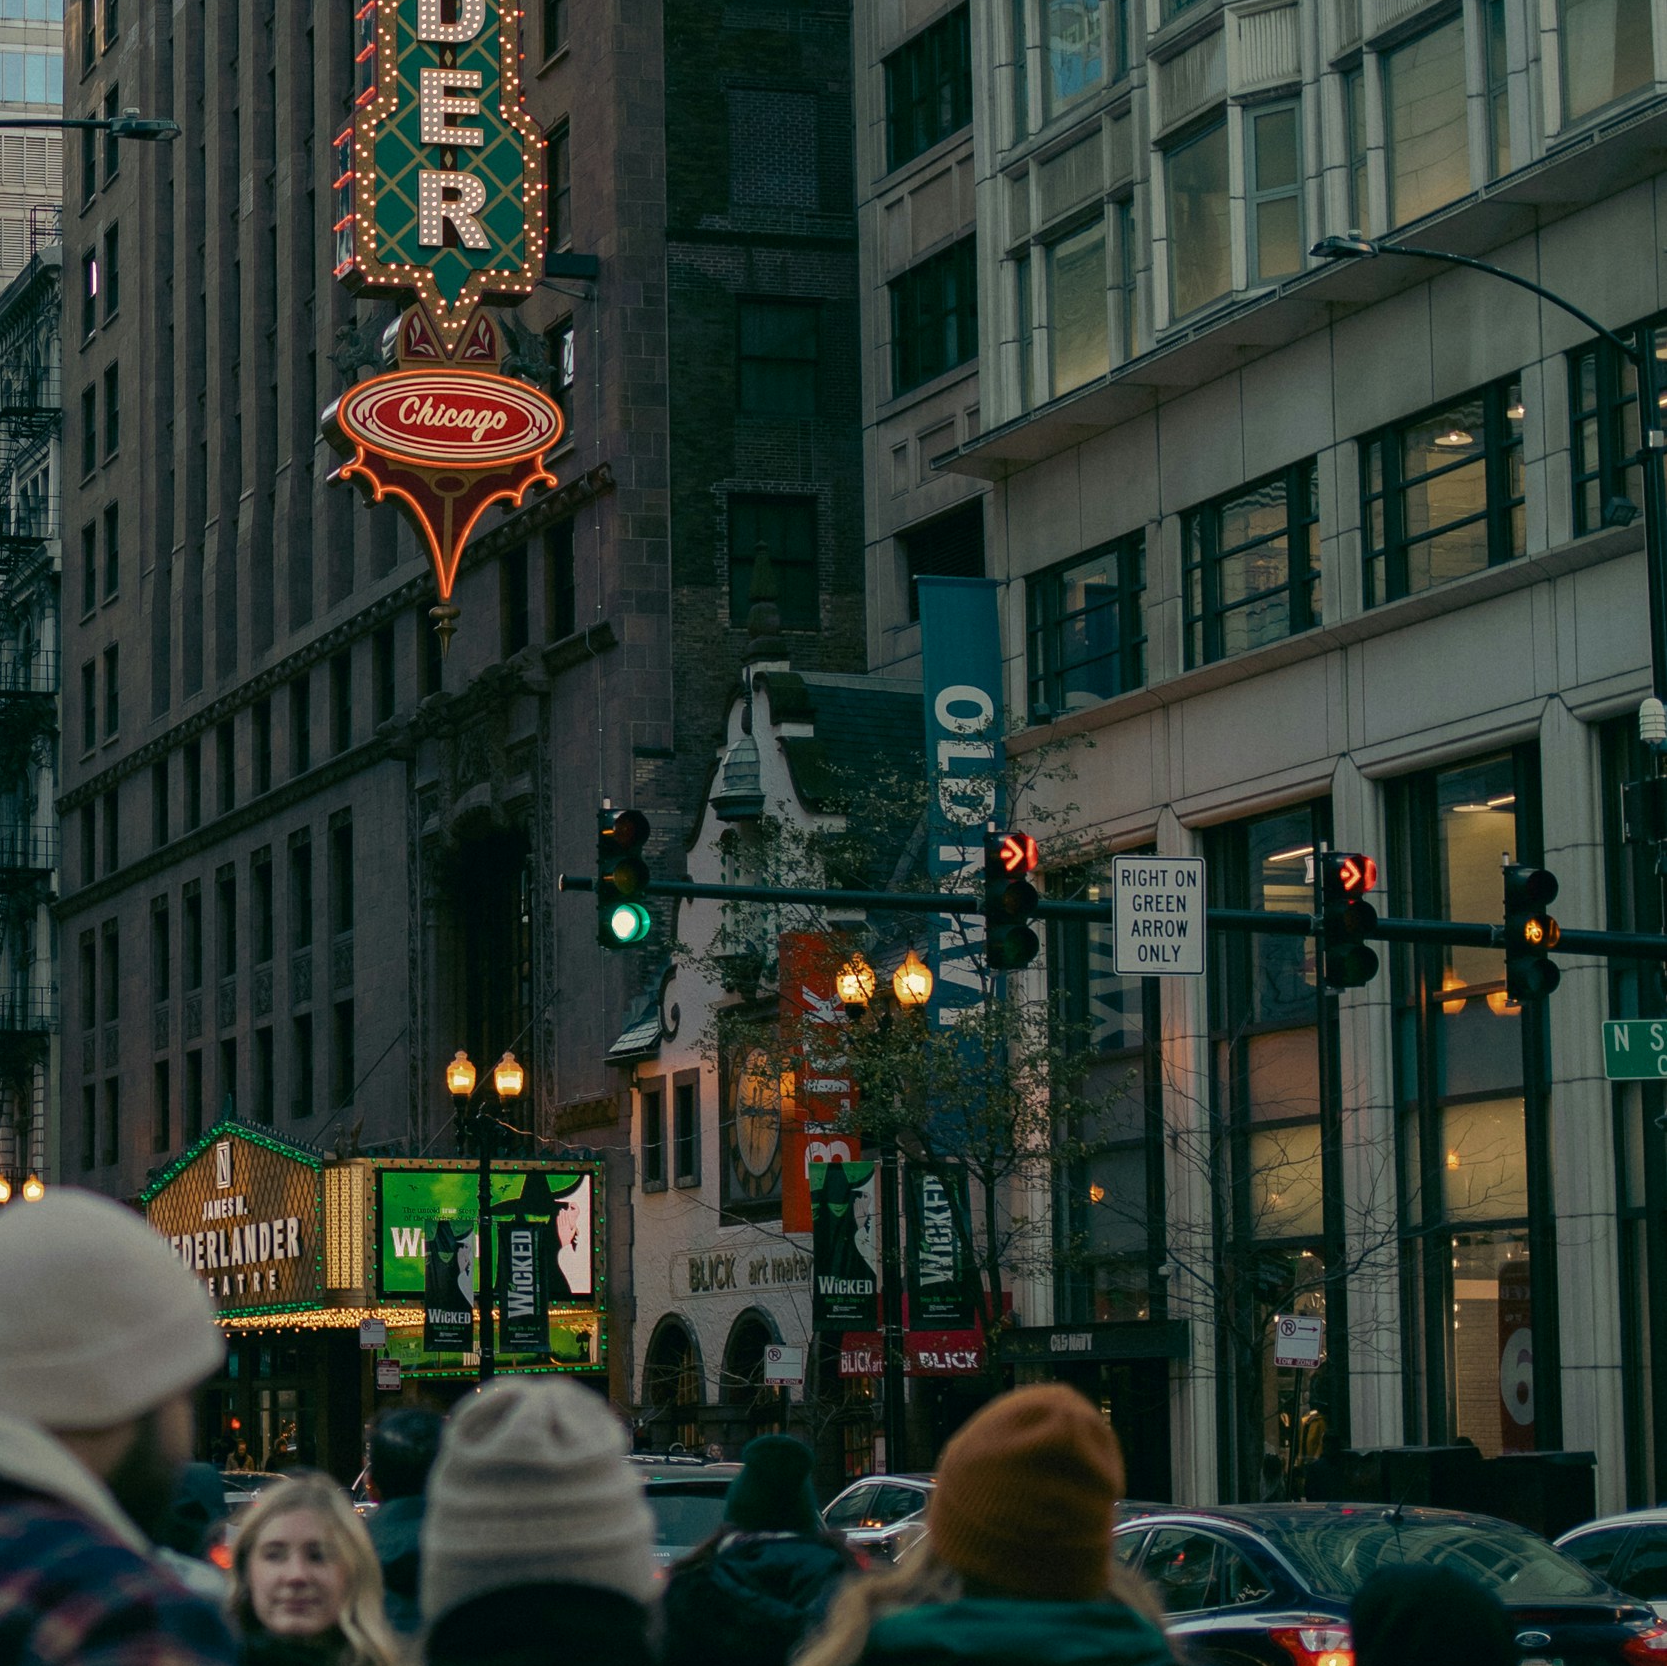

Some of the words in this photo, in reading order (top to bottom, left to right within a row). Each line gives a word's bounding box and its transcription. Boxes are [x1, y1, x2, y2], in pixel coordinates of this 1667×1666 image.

[399, 395, 508, 443] Chicago
[935, 685, 996, 827] OLD
[1121, 869, 1168, 887] RIGHT
[1175, 870, 1197, 887] ON
[1132, 894, 1187, 912] GREEN
[1131, 920, 1188, 938] ARROW
[1137, 944, 1182, 963] ONLY
[1614, 1023, 1630, 1052] N
[202, 1197, 235, 1222] JAMES
[235, 1195, 249, 1216] M.
[168, 1217, 301, 1271] EDERLANDER
[508, 1230, 535, 1318] WICKED
[688, 1253, 737, 1293] BLICK
[748, 1255, 769, 1285] art
[817, 1276, 874, 1295] WICKED
[428, 1309, 472, 1324] WICKED
[841, 1351, 872, 1373] BLICK
[872, 1356, 883, 1372] art
[918, 1351, 979, 1369] BLICK
